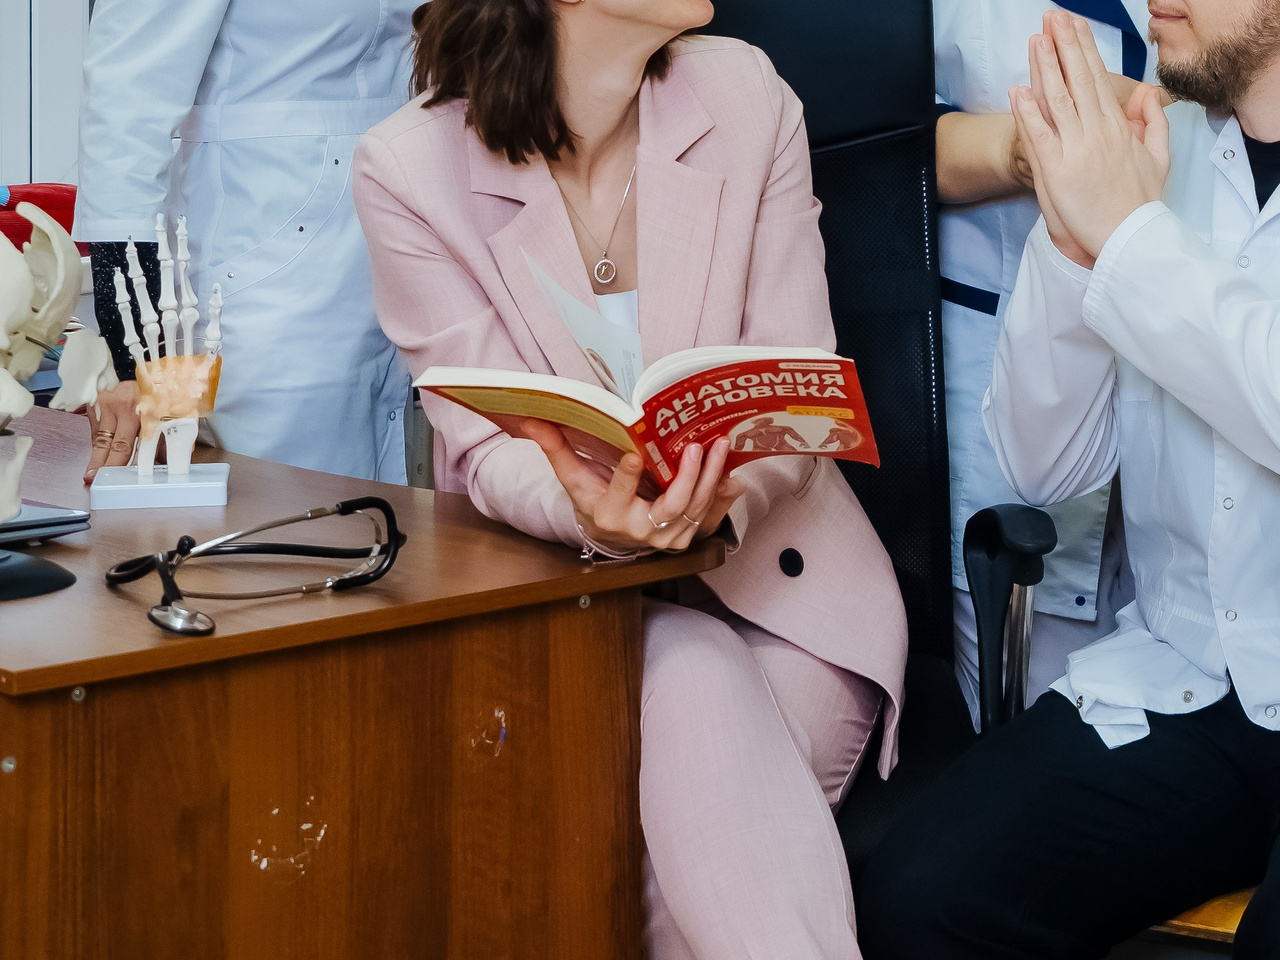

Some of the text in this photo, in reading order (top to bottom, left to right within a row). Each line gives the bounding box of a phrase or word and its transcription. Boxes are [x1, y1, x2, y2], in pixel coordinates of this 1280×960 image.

[655, 372, 845, 428] АНАТОМИЯ
[658, 384, 848, 437] ЧЕЛОВЕКА
[700, 408, 758, 431] Сапиным
